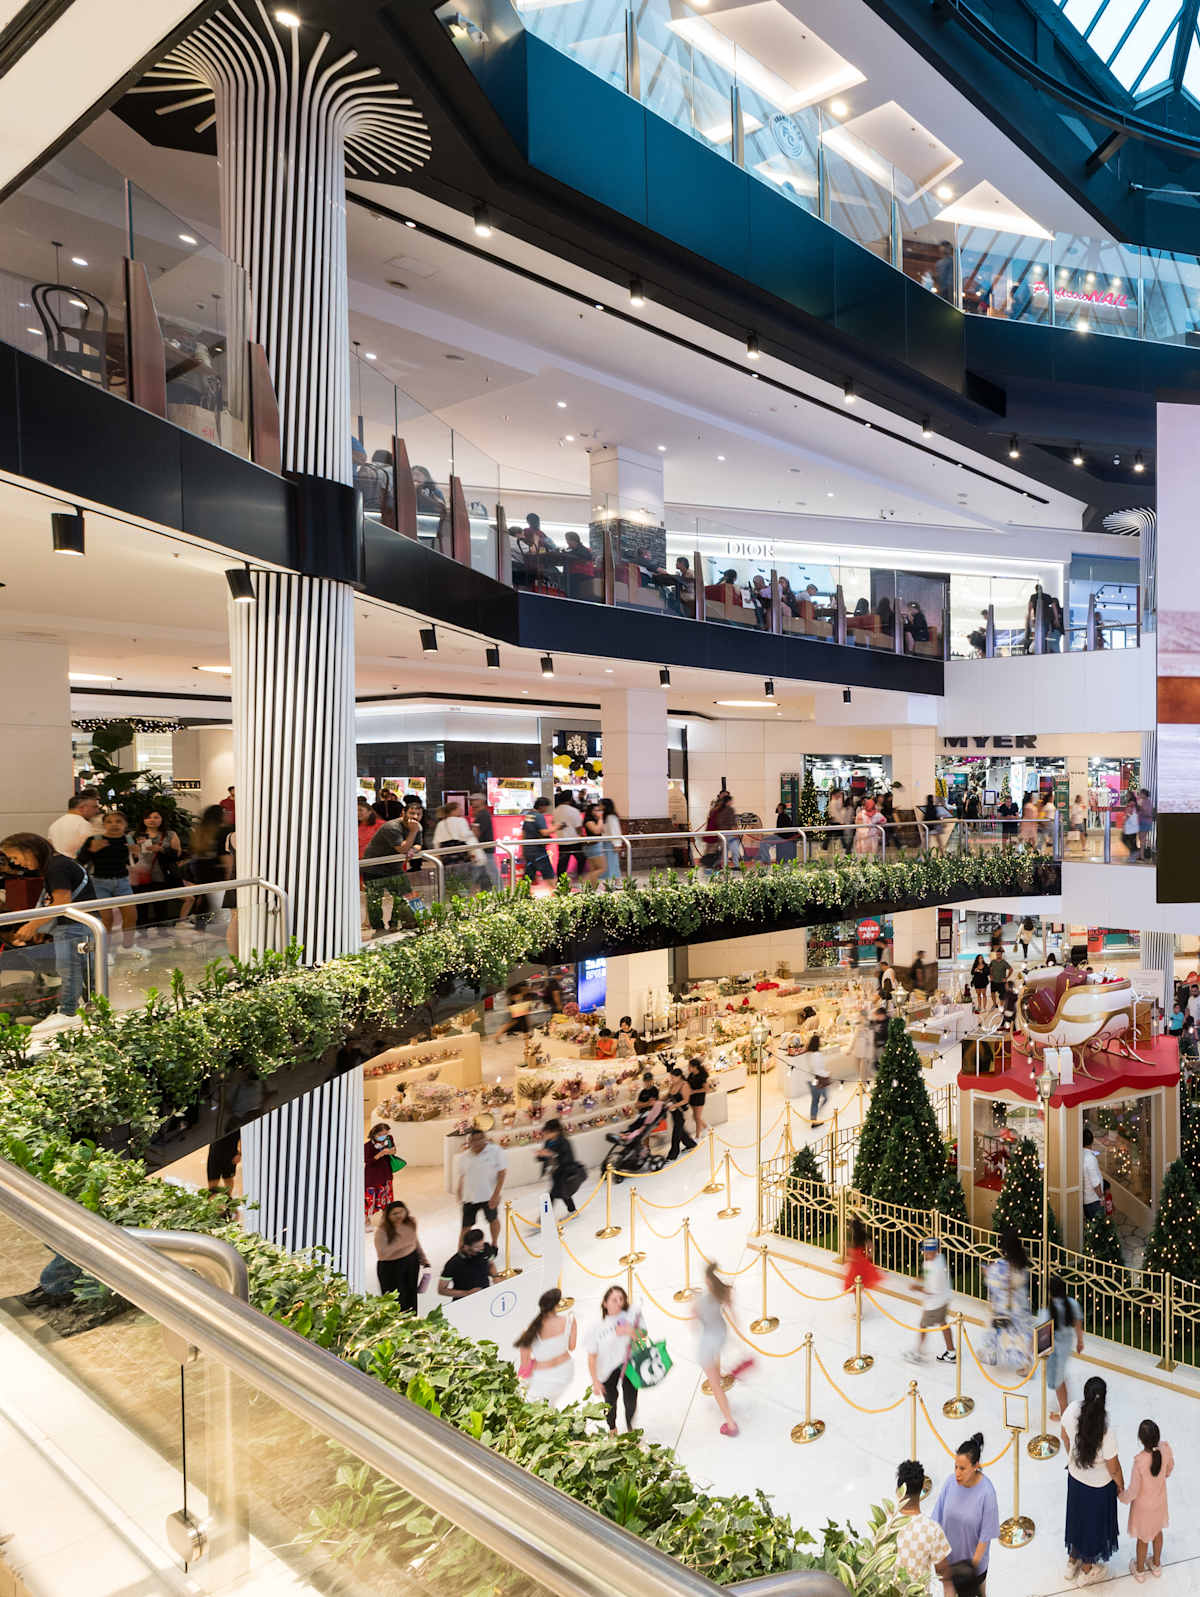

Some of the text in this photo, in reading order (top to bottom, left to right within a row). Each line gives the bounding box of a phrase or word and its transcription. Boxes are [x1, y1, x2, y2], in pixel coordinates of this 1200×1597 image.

[1031, 281, 1128, 309] PrfessioNAIL
[728, 541, 776, 558] DIOR
[944, 735, 1037, 748] MYER
